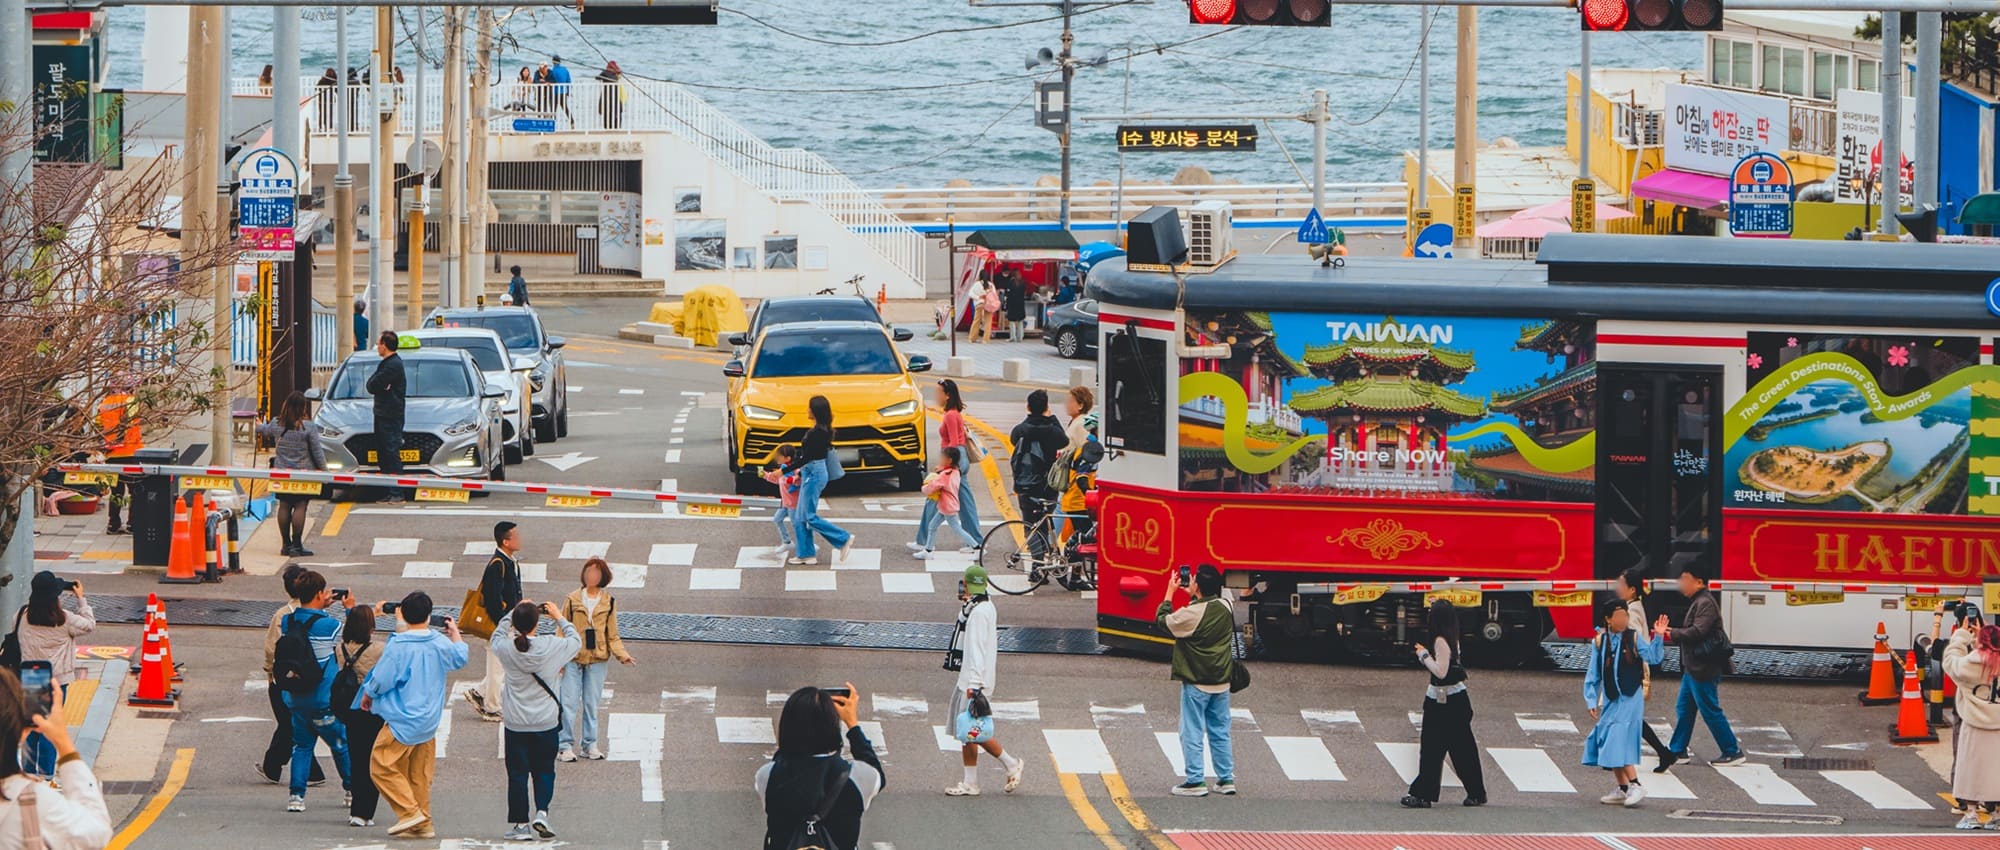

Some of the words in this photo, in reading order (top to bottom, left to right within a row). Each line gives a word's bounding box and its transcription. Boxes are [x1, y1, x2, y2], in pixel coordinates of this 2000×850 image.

[1676, 104, 1709, 136] 아침에
[1713, 109, 1754, 142] 해장으로
[1757, 116, 1770, 145] 딱
[1150, 130, 1200, 148] 방사능
[1206, 130, 1239, 147] 분석
[1684, 135, 1708, 154] 낮에는
[1711, 139, 1734, 158] 별미로
[1326, 321, 1453, 345] TAIWAN
[1738, 402, 1761, 421] The
[1758, 378, 1791, 405] Green
[1791, 360, 1867, 383] Destinations
[1862, 379, 1886, 413] Story
[1887, 390, 1933, 415] Awards
[1330, 447, 1389, 462] Share
[1395, 448, 1446, 464] NOW
[1609, 454, 1647, 462] TAIWAN
[194, 478, 230, 488] 일단정지
[282, 482, 318, 492] 일단정지
[1765, 489, 1785, 503] 해변
